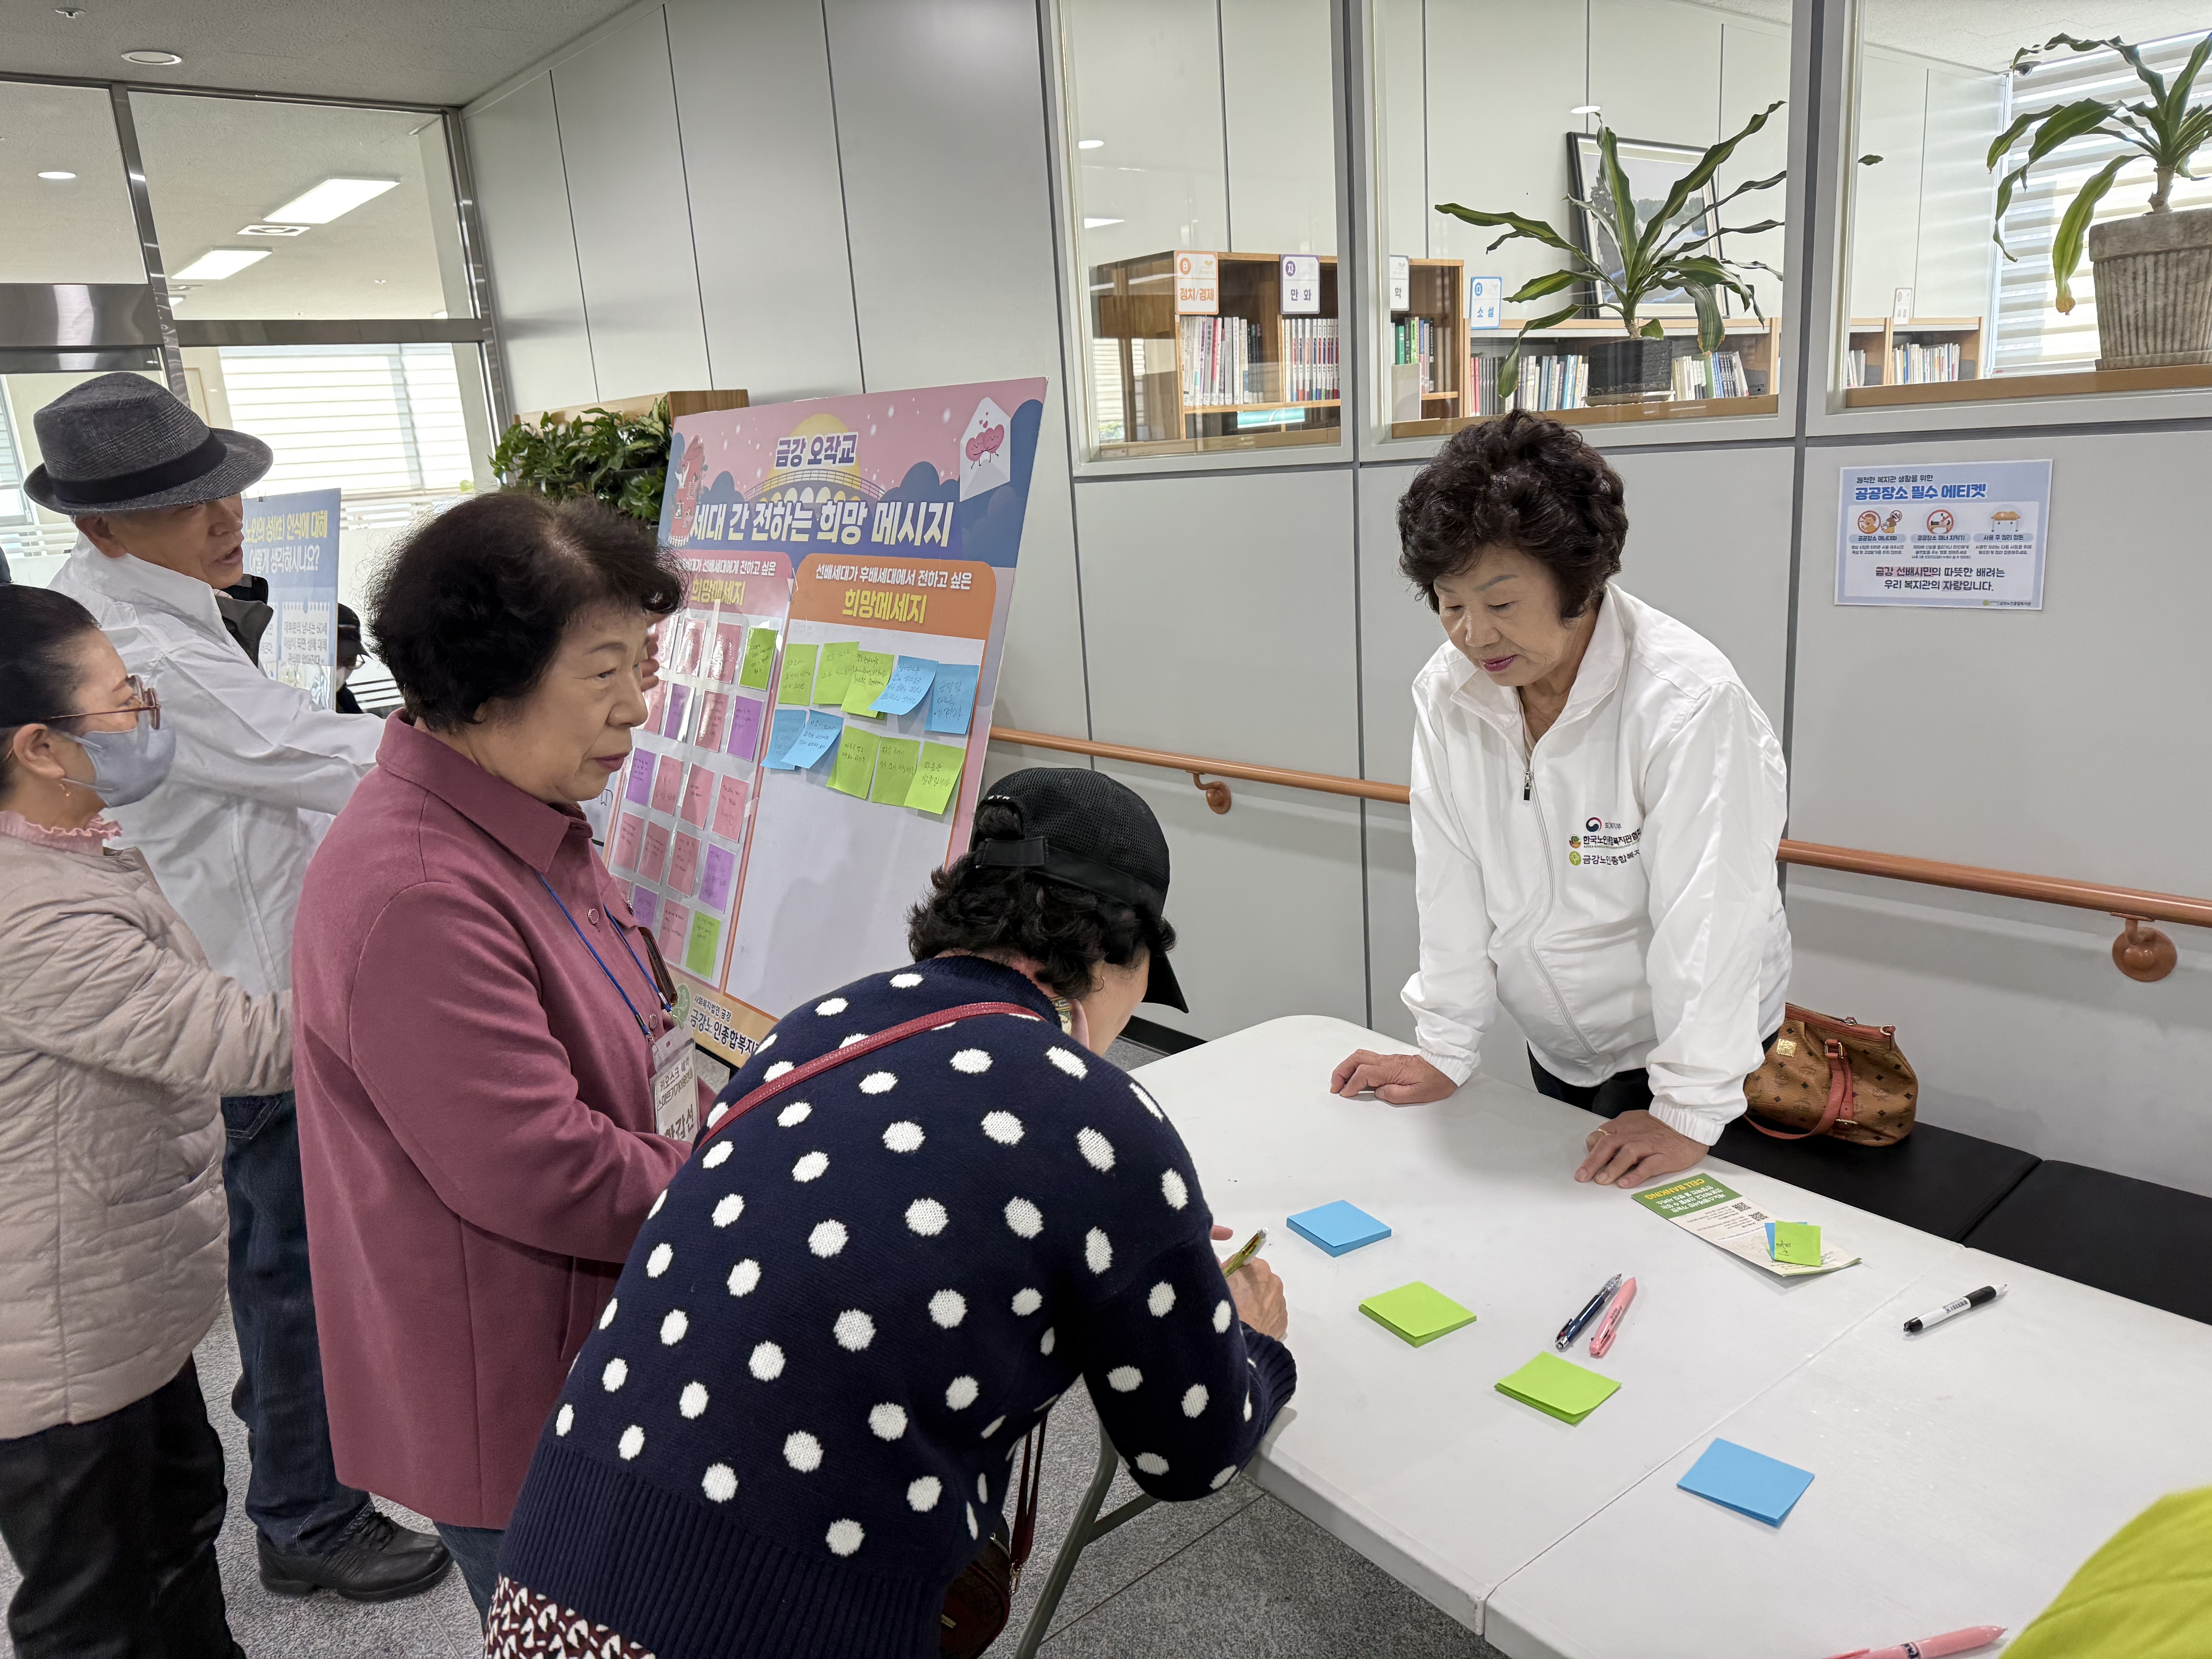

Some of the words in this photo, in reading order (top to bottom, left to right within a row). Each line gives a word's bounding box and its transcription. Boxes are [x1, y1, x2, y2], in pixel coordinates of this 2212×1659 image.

[1287, 264, 1294, 274] 자
[1180, 288, 1214, 301] 정치/경제
[776, 436, 807, 468] 금강
[807, 434, 857, 465] 오작교
[1855, 486, 1908, 500] 공공장소
[1911, 485, 1939, 500] 필수
[1941, 483, 1987, 498] 에티켓
[244, 517, 265, 543] 노인의
[287, 512, 310, 540] 인식에
[311, 510, 328, 538] 대해
[689, 504, 727, 541] 세대
[728, 503, 749, 541] 간
[751, 501, 812, 542] 전하는
[817, 500, 868, 545] 희망
[871, 502, 954, 547] 메시지
[249, 548, 270, 574] 어떻게
[270, 544, 320, 574] 생각하시나요?
[702, 559, 740, 574] 선배세대에게
[740, 560, 761, 575] 전하고
[761, 561, 776, 576] 싶은
[1875, 566, 1894, 577] 금강
[1897, 567, 1941, 577] 선배시민의
[1944, 567, 1973, 577] 따뜻한
[1976, 568, 2005, 578] 배려는
[816, 563, 859, 582] 선배세대가
[859, 566, 916, 586] 후배세대에서
[917, 569, 949, 588] 전하고
[950, 571, 972, 590] 싶은
[1884, 579, 1902, 589] 우리
[1905, 580, 1940, 591] 복지관의
[1942, 580, 1994, 591] 자랑입니다.
[690, 578, 746, 606] 희망메세지
[842, 588, 927, 624] 희망메세지
[694, 994, 720, 1017] 사회복지법인
[721, 1008, 732, 1022] 금강
[690, 1008, 760, 1055] 금강노인종합복지
[660, 1066, 680, 1092] 키오스크
[1644, 1185, 1686, 1200] BANKING
[1683, 1178, 1705, 1188] CELL
